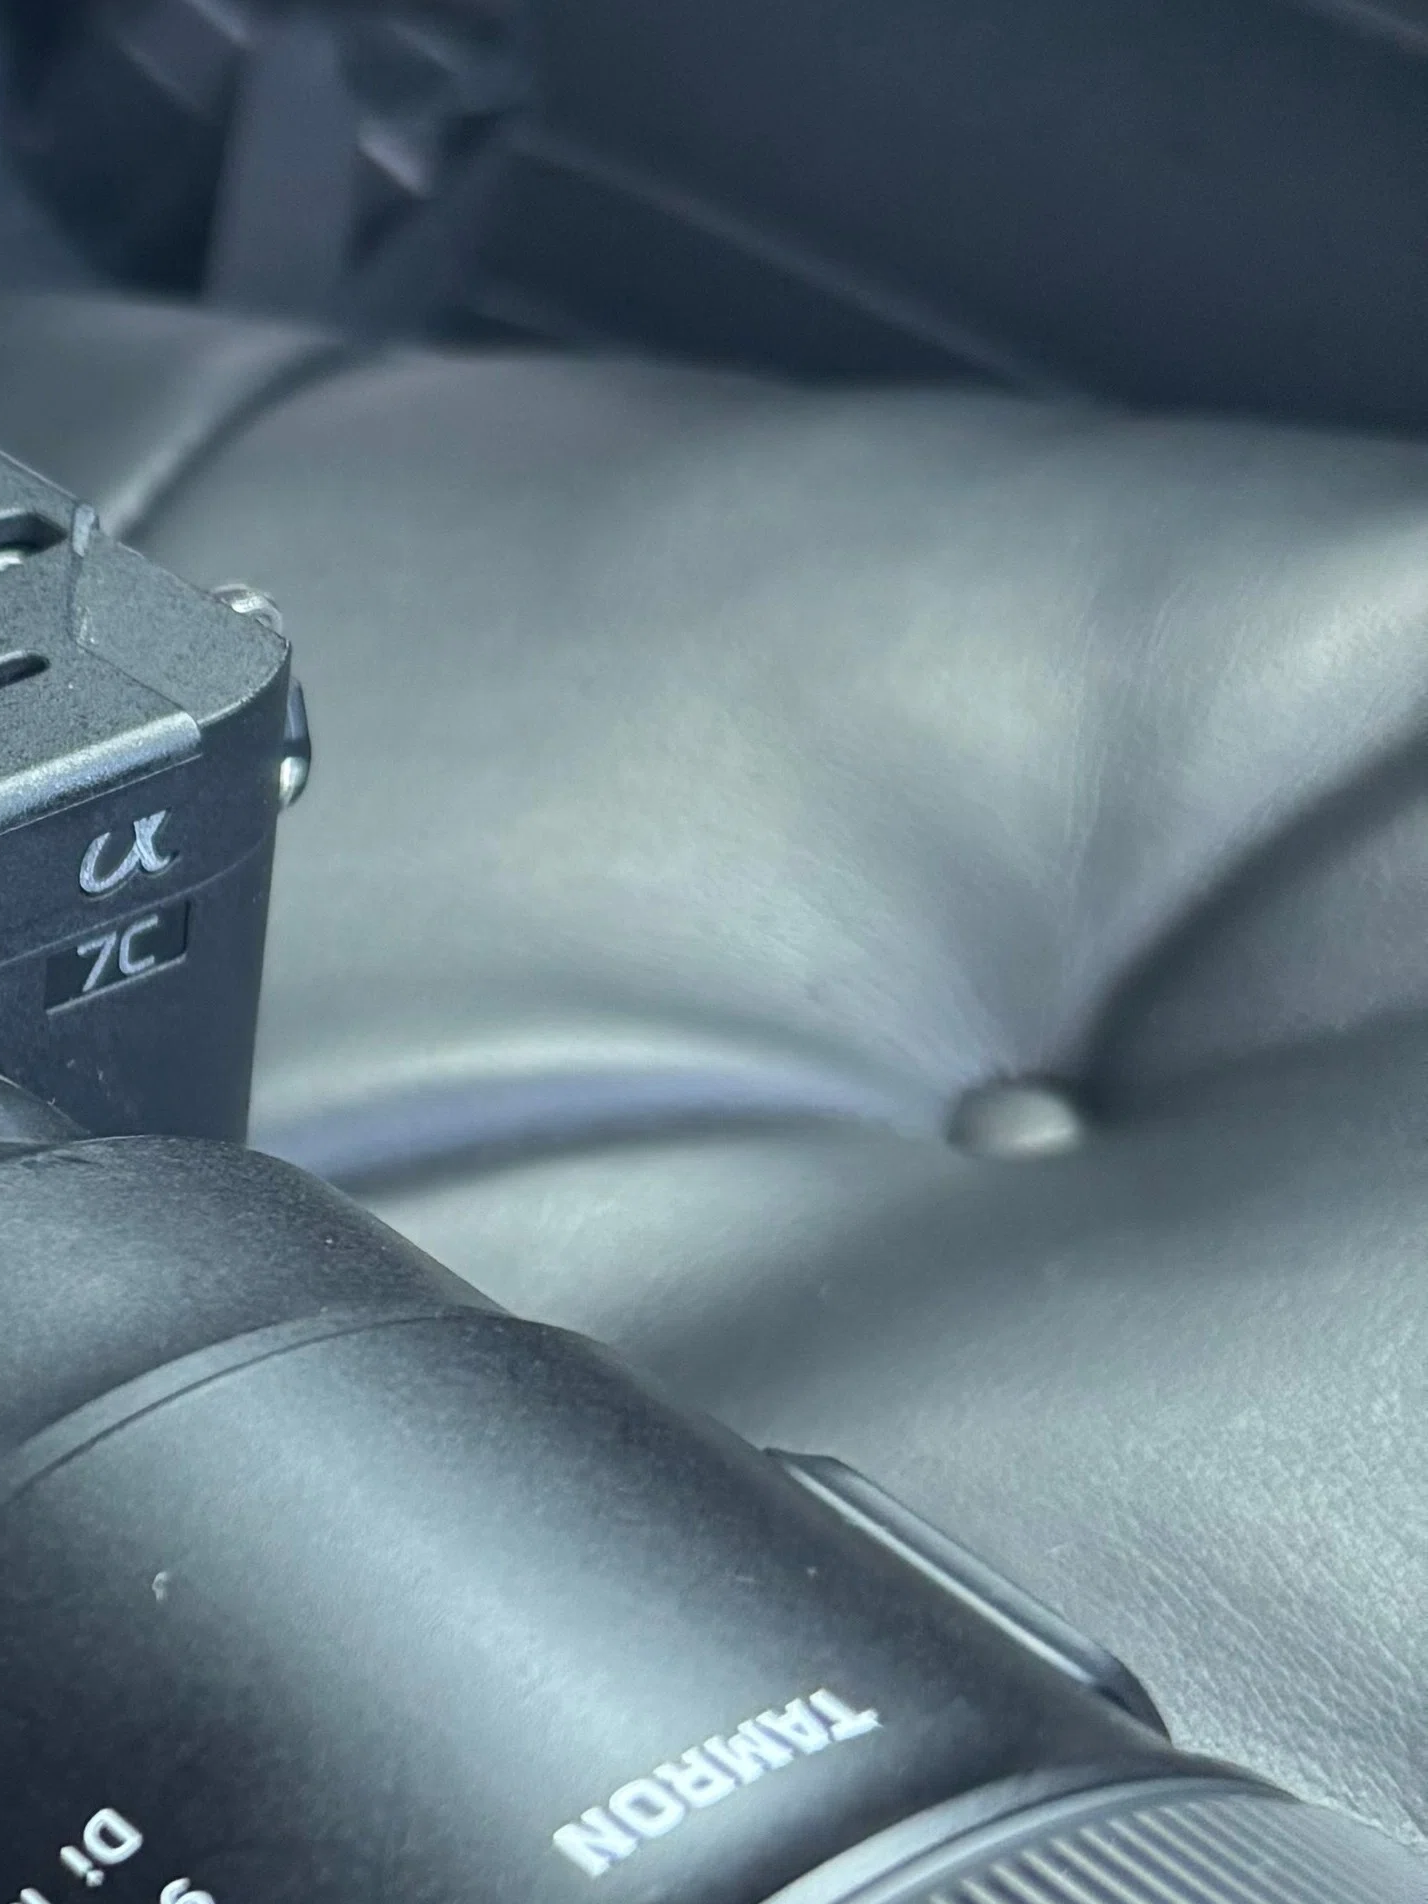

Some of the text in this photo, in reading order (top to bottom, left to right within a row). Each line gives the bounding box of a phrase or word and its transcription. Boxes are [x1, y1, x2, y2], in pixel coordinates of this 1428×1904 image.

[77, 915, 158, 993] 7C
[552, 1687, 883, 1878] TAMRON
[61, 1807, 143, 1887] Di
